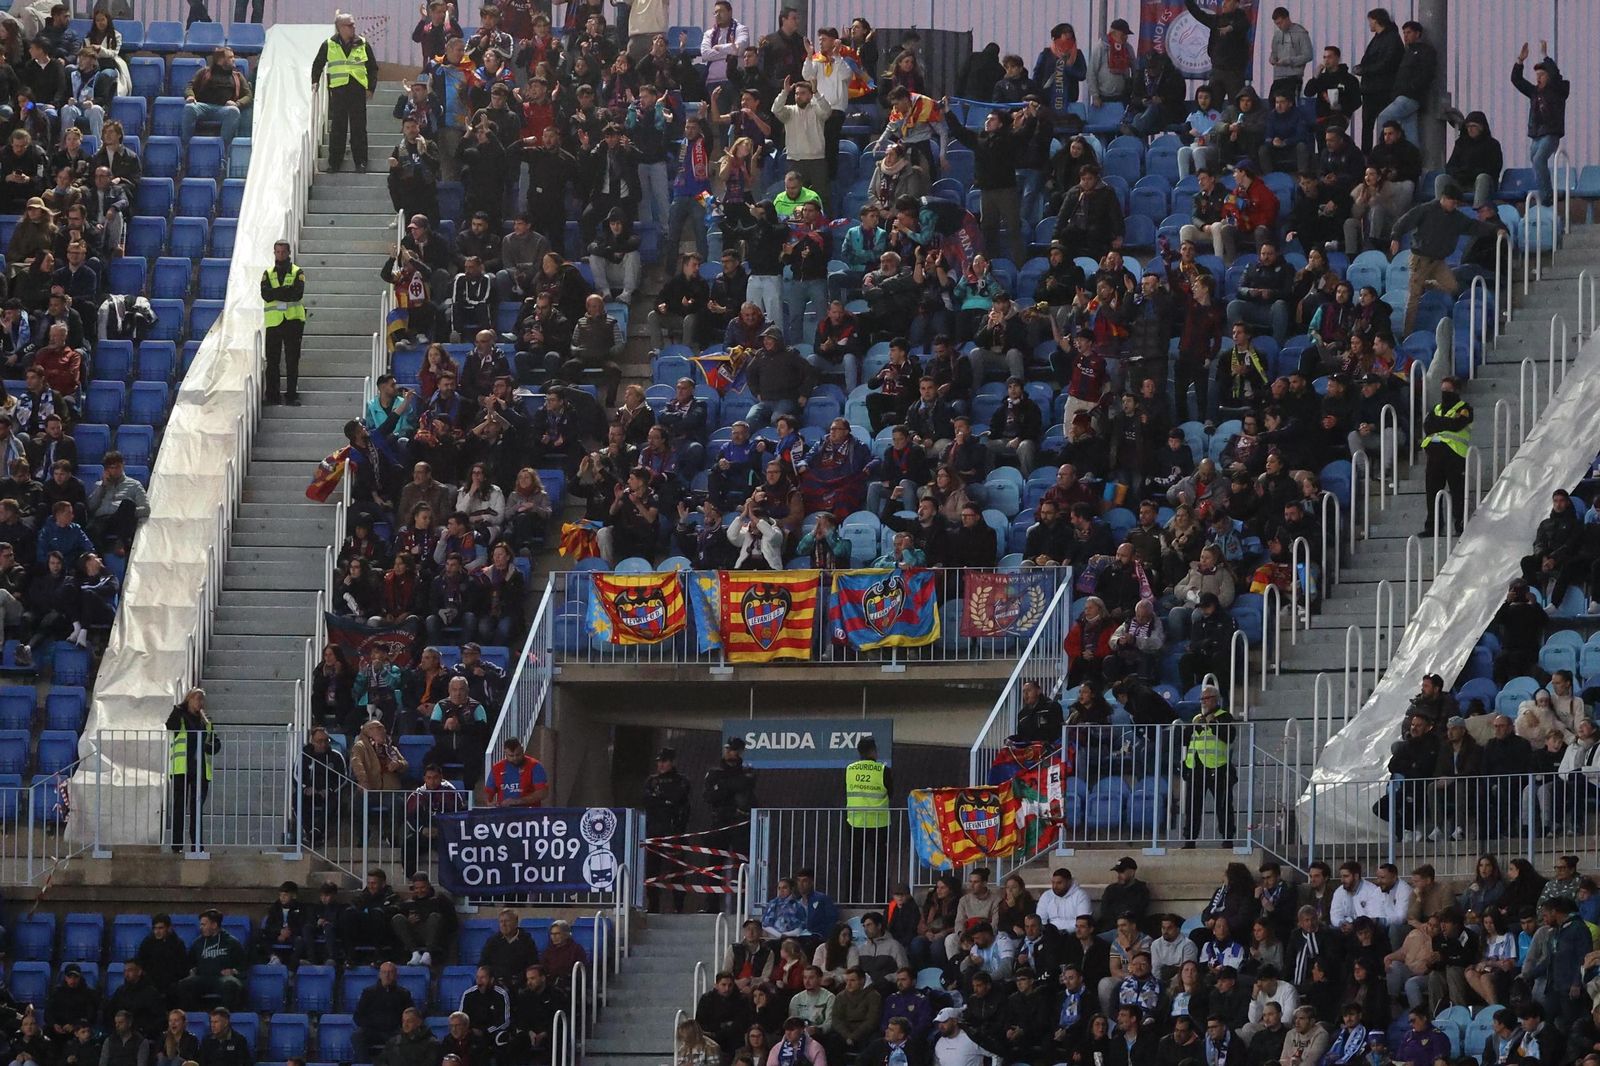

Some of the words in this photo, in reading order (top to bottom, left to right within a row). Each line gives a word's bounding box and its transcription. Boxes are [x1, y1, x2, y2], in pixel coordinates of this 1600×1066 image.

[745, 732, 815, 750] SALIDA
[855, 774, 871, 783] 022
[460, 815, 568, 841] Levante
[448, 842, 509, 863] Fans
[522, 838, 581, 860] 1909
[462, 864, 501, 886] On
[511, 862, 566, 883] Tour
